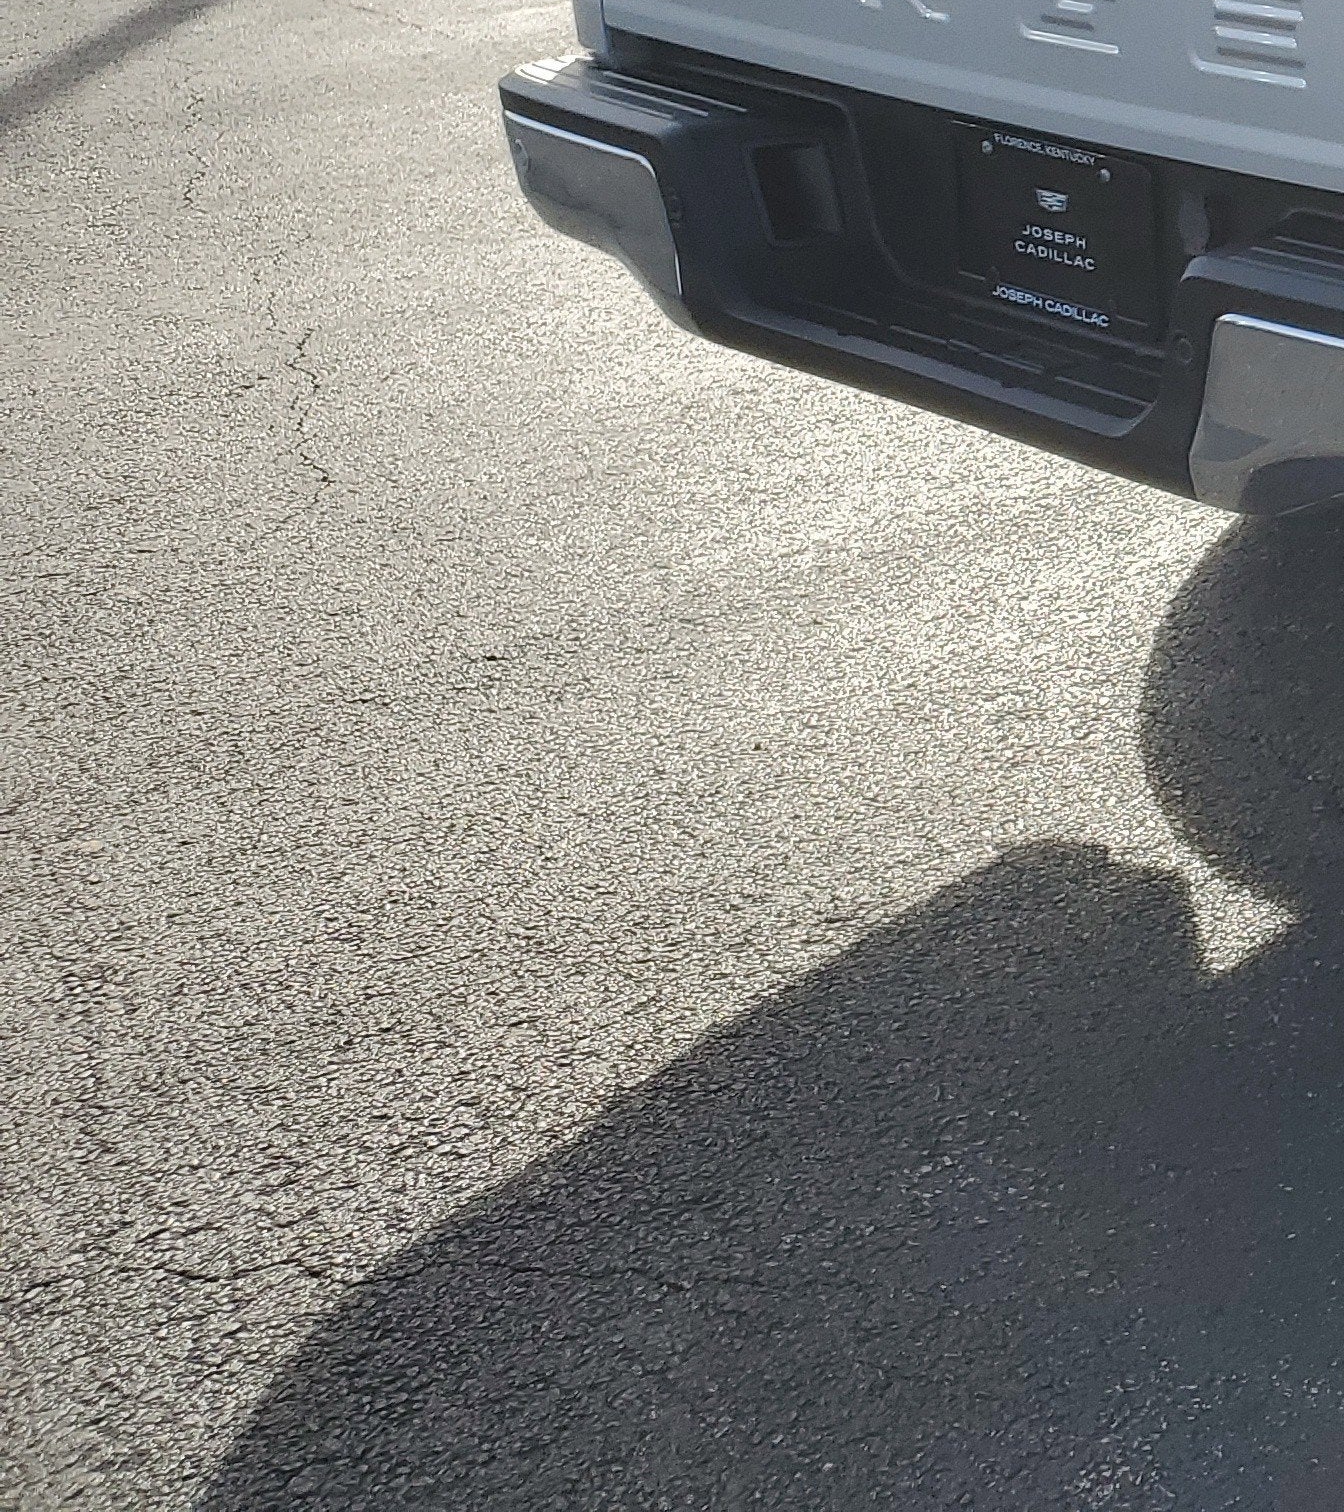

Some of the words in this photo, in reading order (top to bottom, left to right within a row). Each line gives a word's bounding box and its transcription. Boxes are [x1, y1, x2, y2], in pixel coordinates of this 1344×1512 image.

[1045, 145, 1095, 166] KENTUCKY
[1022, 224, 1087, 250] JOSEPH
[1015, 240, 1096, 271] CADILLAC
[992, 285, 1043, 310] JOSEPH
[1044, 299, 1110, 328] CADILLAC
